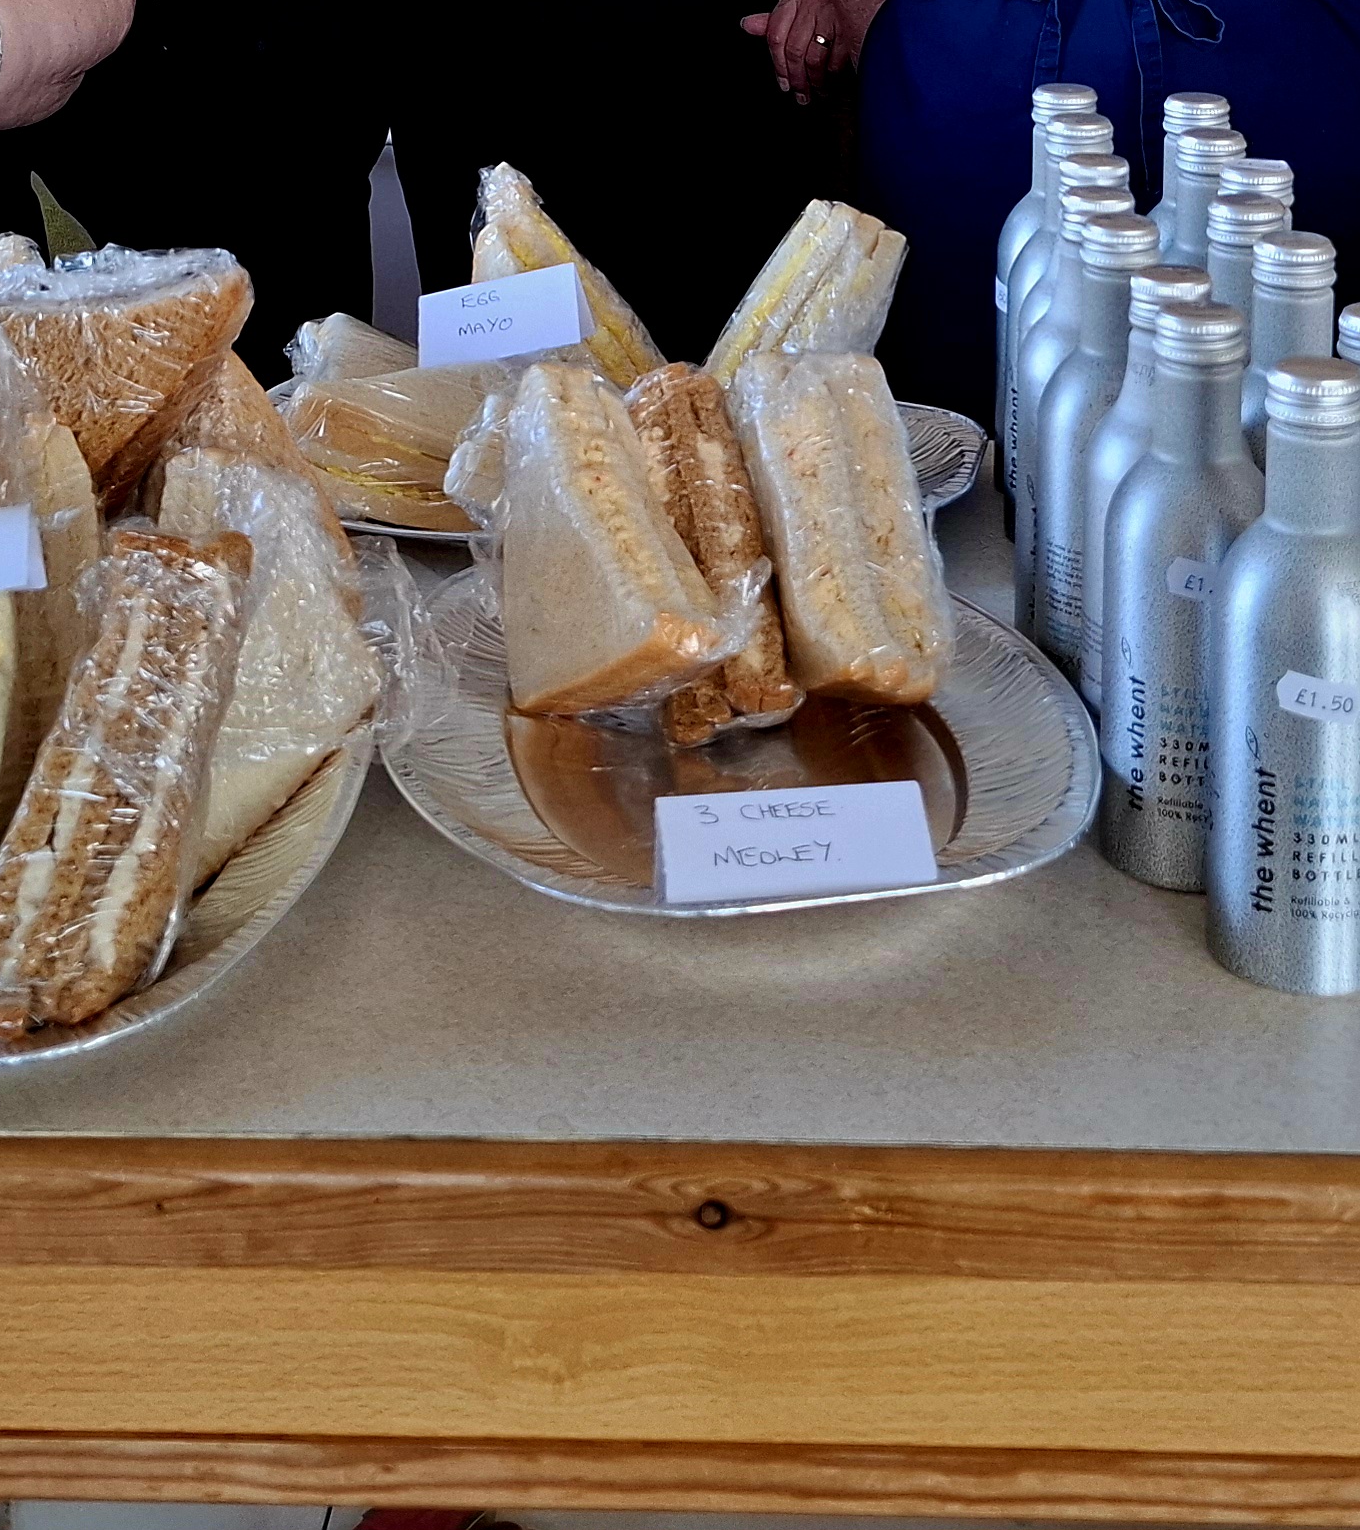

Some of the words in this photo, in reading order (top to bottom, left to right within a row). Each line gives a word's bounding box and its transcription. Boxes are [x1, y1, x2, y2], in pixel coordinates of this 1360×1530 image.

[461, 290, 501, 309] EGG
[458, 317, 513, 337] MAYO
[1010, 387, 1019, 454] whent
[1009, 457, 1018, 490] the
[1184, 575, 1213, 593] £1.
[1294, 687, 1354, 713] £1.50
[1127, 675, 1147, 760] whent
[1160, 737, 1210, 752] 330M
[1126, 766, 1145, 811] the
[1158, 772, 1206, 787] BOTT
[694, 805, 719, 824] 3
[740, 800, 836, 821] CHEESE
[1253, 768, 1277, 858] whent
[1292, 831, 1360, 845] 330ML
[1292, 850, 1359, 863] REFILL
[1250, 865, 1275, 913] the
[1290, 895, 1340, 907] Refillable
